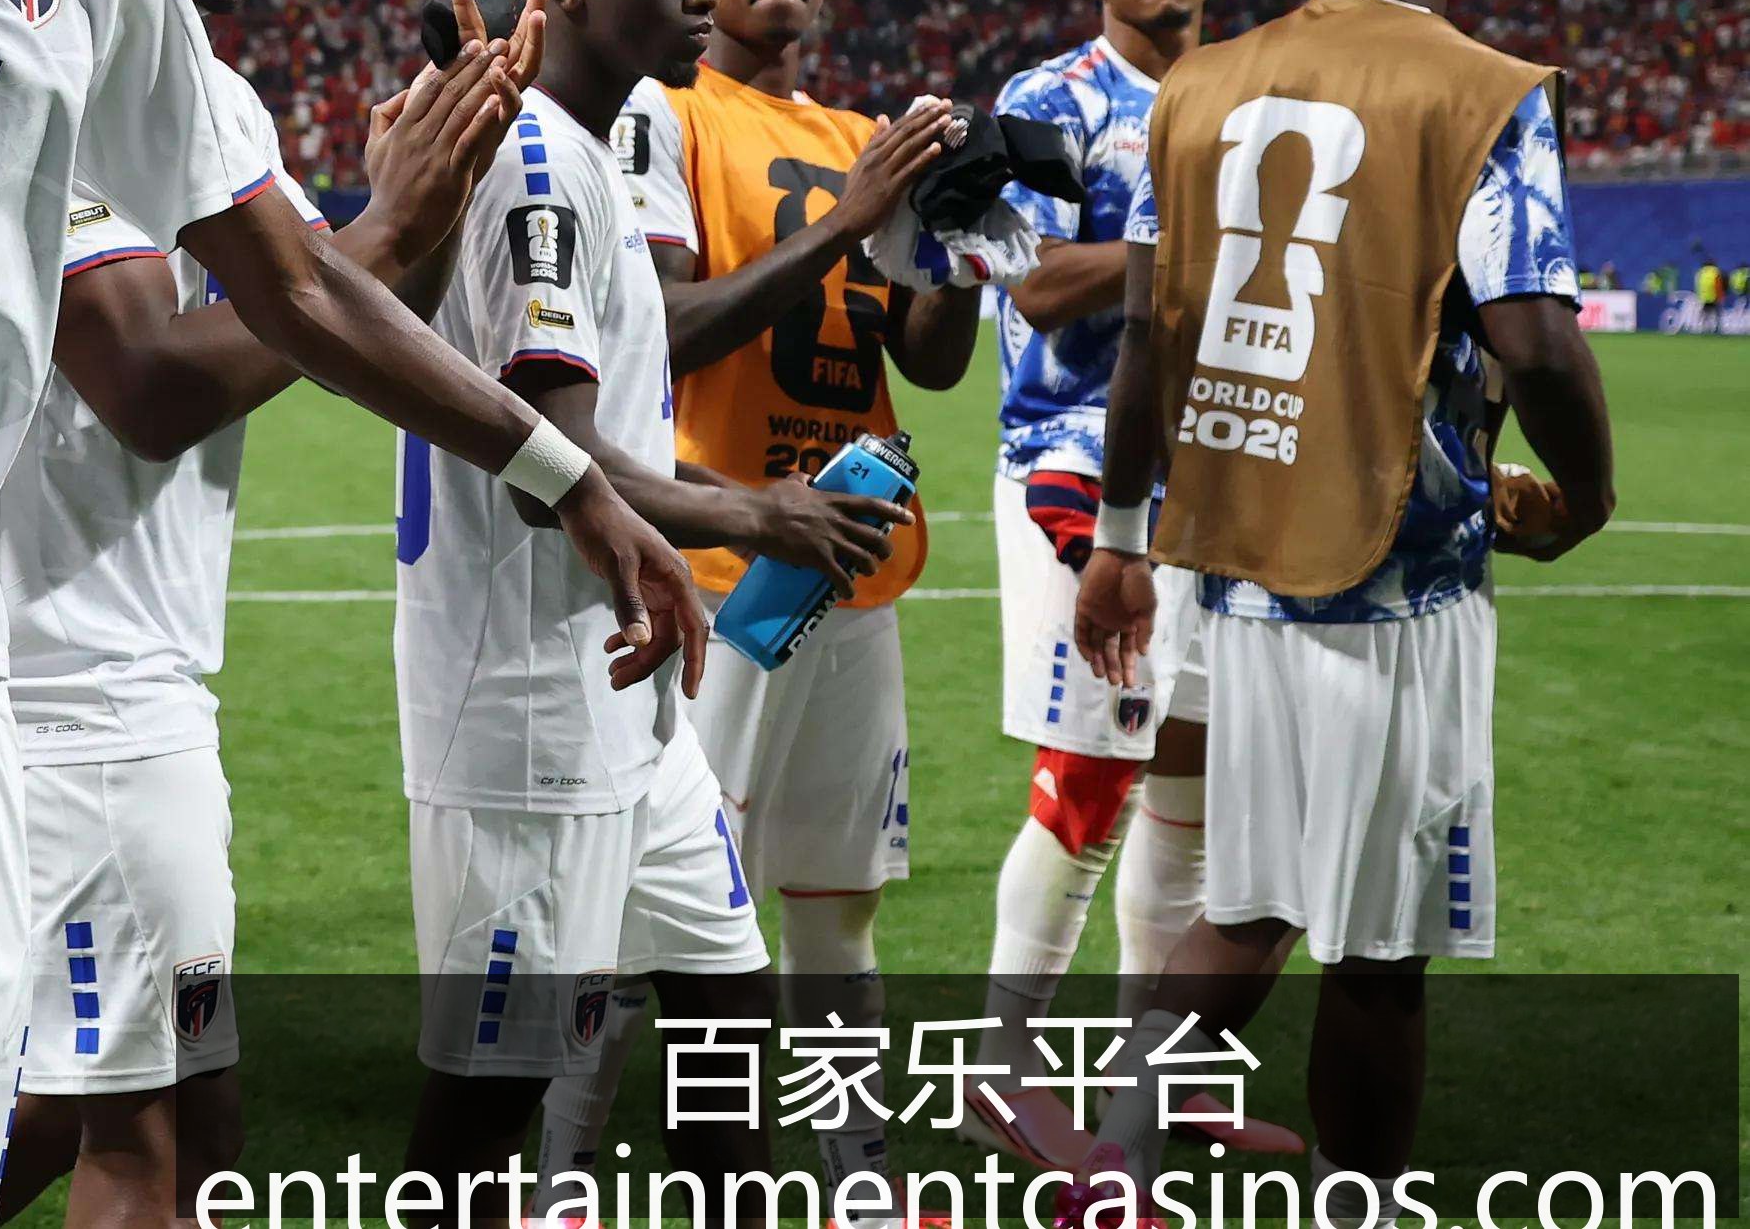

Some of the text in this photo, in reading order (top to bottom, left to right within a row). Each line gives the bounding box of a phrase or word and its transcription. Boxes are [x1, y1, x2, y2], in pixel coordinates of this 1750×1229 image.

[70, 206, 105, 221] DEBUT
[540, 309, 571, 322] DEBUT
[1223, 316, 1292, 353] FIFA
[811, 356, 863, 390] FIFA
[1187, 375, 1305, 421] ORLD CUP
[768, 413, 848, 444] WORLD
[850, 461, 871, 480] 21
[863, 436, 915, 477] POWERADE
[179, 960, 221, 982] FCF
